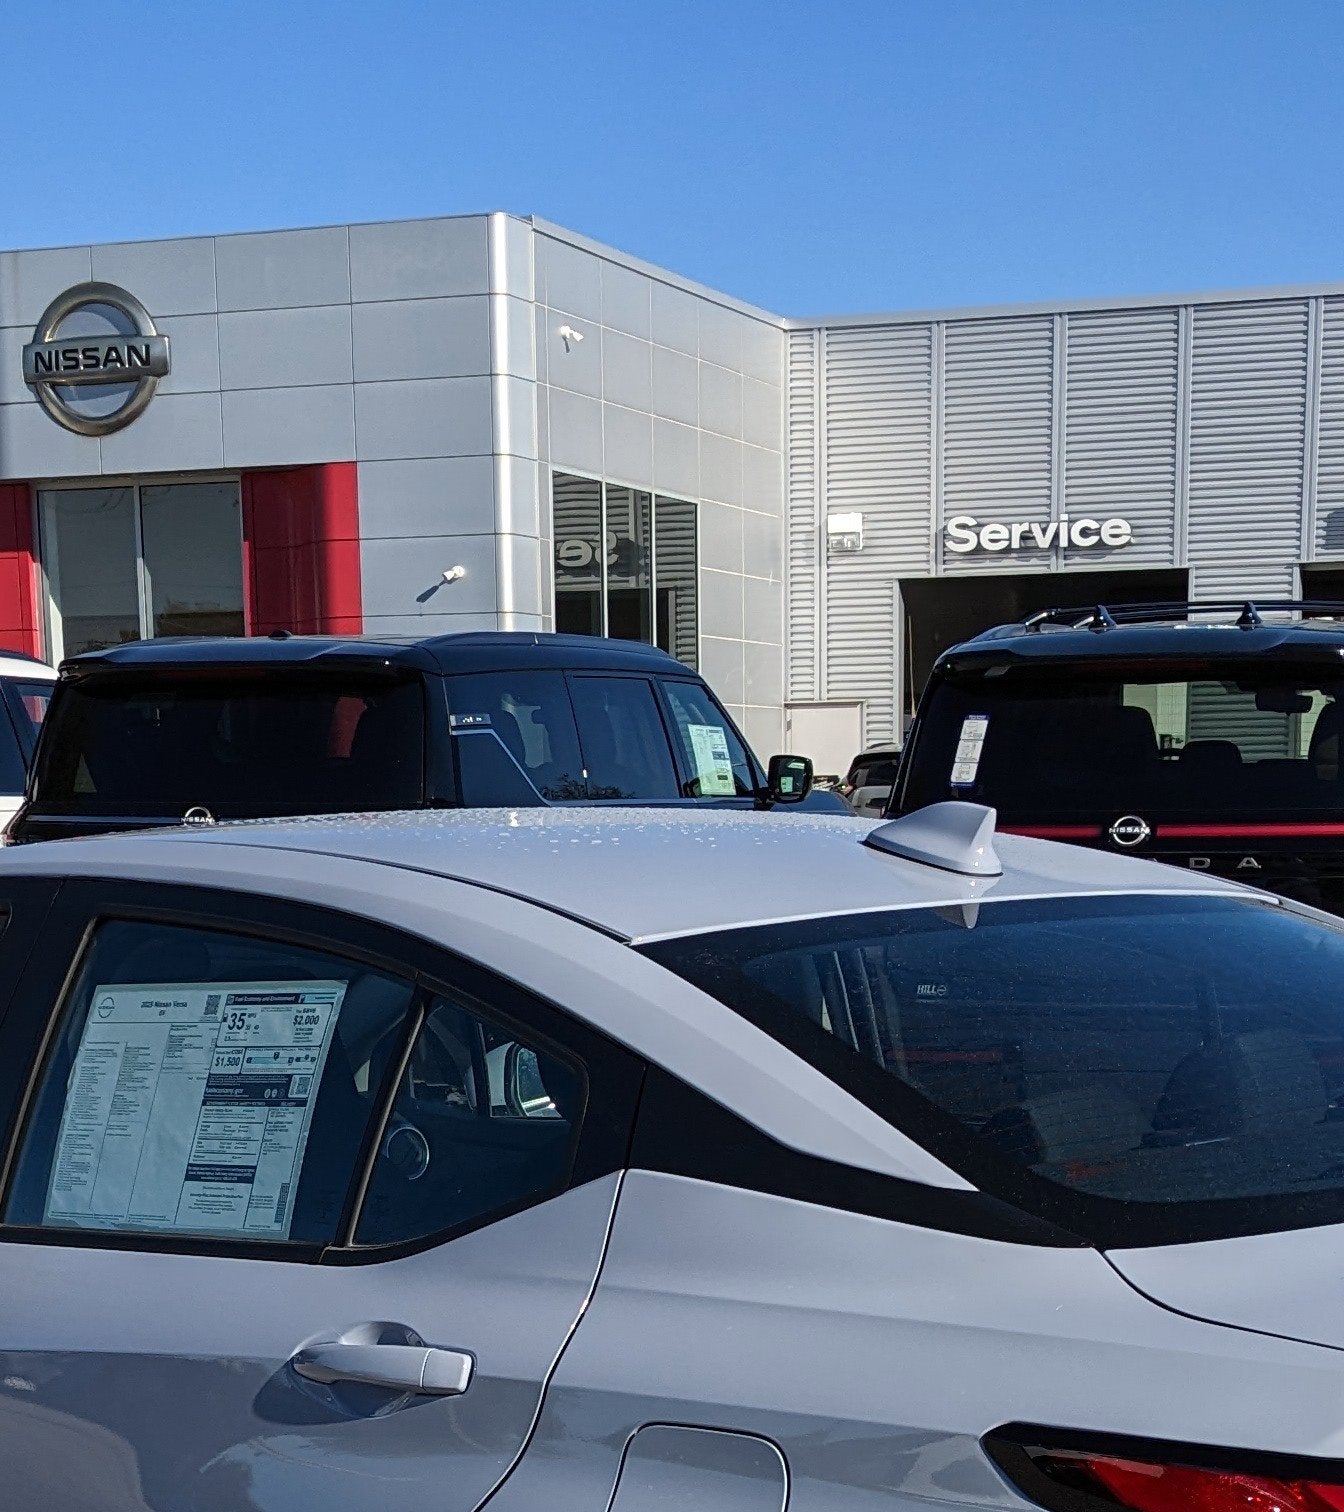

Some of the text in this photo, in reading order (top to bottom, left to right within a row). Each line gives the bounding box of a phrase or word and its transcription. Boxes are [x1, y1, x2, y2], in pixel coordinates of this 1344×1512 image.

[34, 344, 151, 374] NISSAN
[944, 513, 1132, 553] Service
[1109, 826, 1151, 834] NISSAN
[228, 1012, 247, 1031] 35
